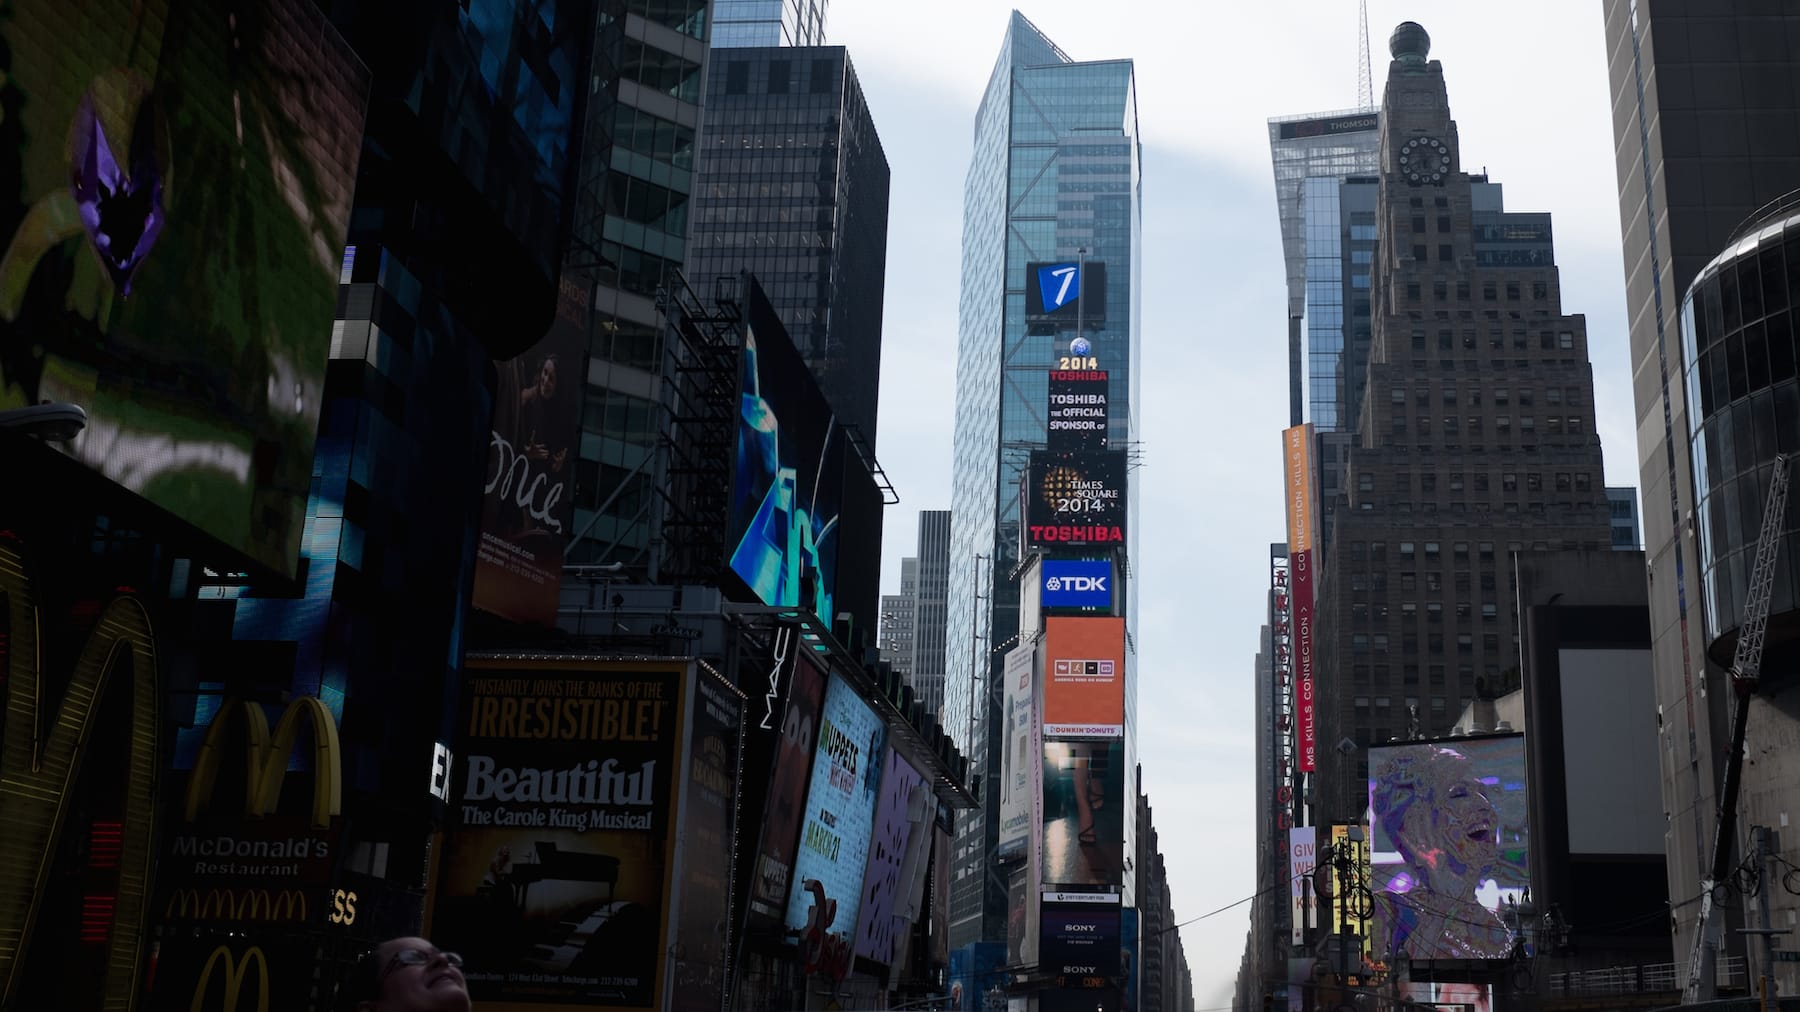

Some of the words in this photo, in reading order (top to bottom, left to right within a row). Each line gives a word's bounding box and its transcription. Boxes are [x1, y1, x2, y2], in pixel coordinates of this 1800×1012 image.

[1330, 119, 1377, 130] THOMSON
[1060, 357, 1098, 370] 2014
[1050, 371, 1107, 381] TOSHIBA
[1050, 395, 1106, 404] TOSHIBA
[1062, 408, 1105, 417] OFFICIAL
[1050, 421, 1096, 430] SPONSOR
[1292, 430, 1302, 448] MS
[1294, 452, 1303, 486] KILLS
[1070, 480, 1104, 490] TIMES
[1076, 489, 1118, 499] SQUARE
[1058, 498, 1102, 512] 2014
[1030, 525, 1123, 542] TOSHIBA
[1296, 491, 1306, 571] CONNECTION
[1060, 577, 1106, 591] TDK
[1301, 617, 1312, 700] CONNECTION
[531, 681, 562, 697] JOINS
[565, 681, 585, 697] THE
[588, 681, 624, 698] RANKS
[627, 682, 639, 698] OF
[639, 683, 664, 698] THE
[1304, 705, 1313, 742] KILLS
[1306, 747, 1315, 765] MS
[429, 742, 454, 805] EX
[463, 755, 656, 806] Beautiful
[462, 805, 492, 825] The
[493, 806, 546, 827] Carole
[549, 809, 588, 833] King
[589, 810, 654, 830] Musical
[172, 835, 329, 859] McDonald's
[1294, 844, 1315, 858] GIV
[193, 861, 300, 877] Restaurant
[328, 889, 358, 926] SS
[1065, 924, 1096, 932] SONY
[1063, 966, 1096, 974] SONY
